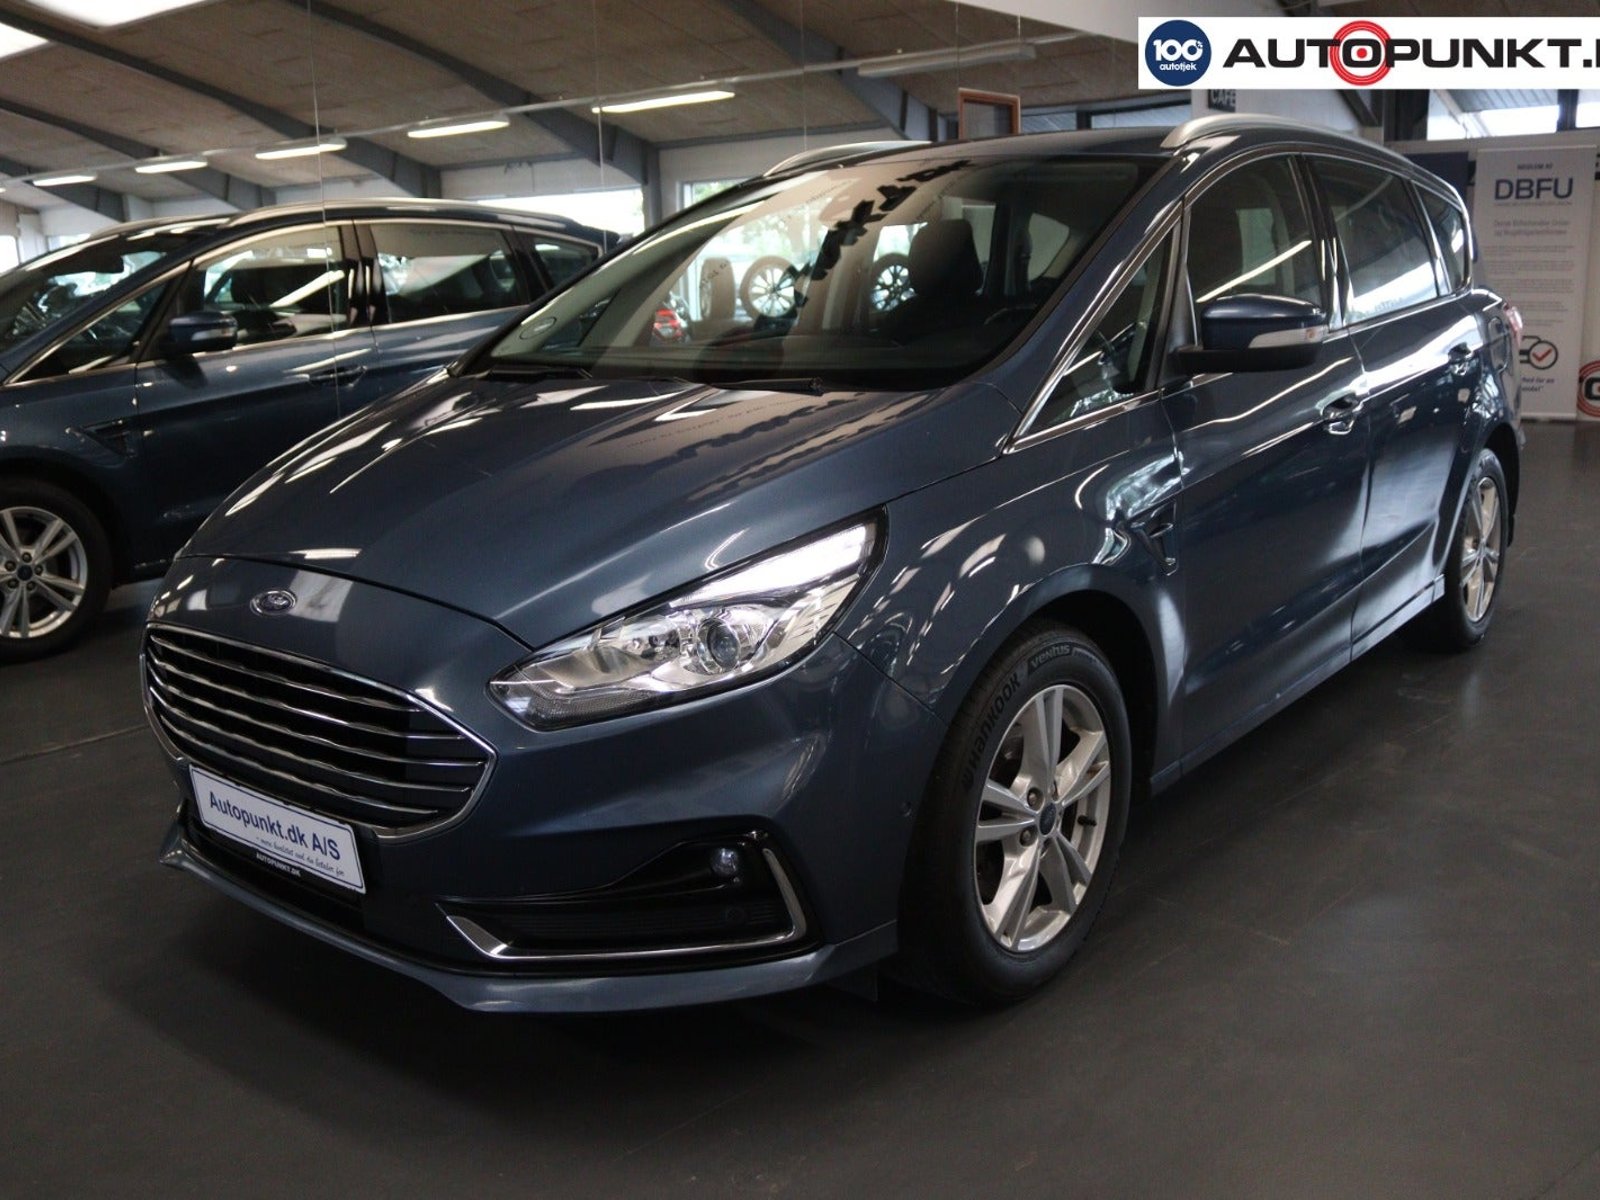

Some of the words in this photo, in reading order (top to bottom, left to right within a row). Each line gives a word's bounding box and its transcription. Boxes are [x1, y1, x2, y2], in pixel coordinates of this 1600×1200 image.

[1495, 178, 1573, 200] DBFU
[209, 791, 308, 849] Autopunkt.dk
[312, 832, 341, 861] A/S
